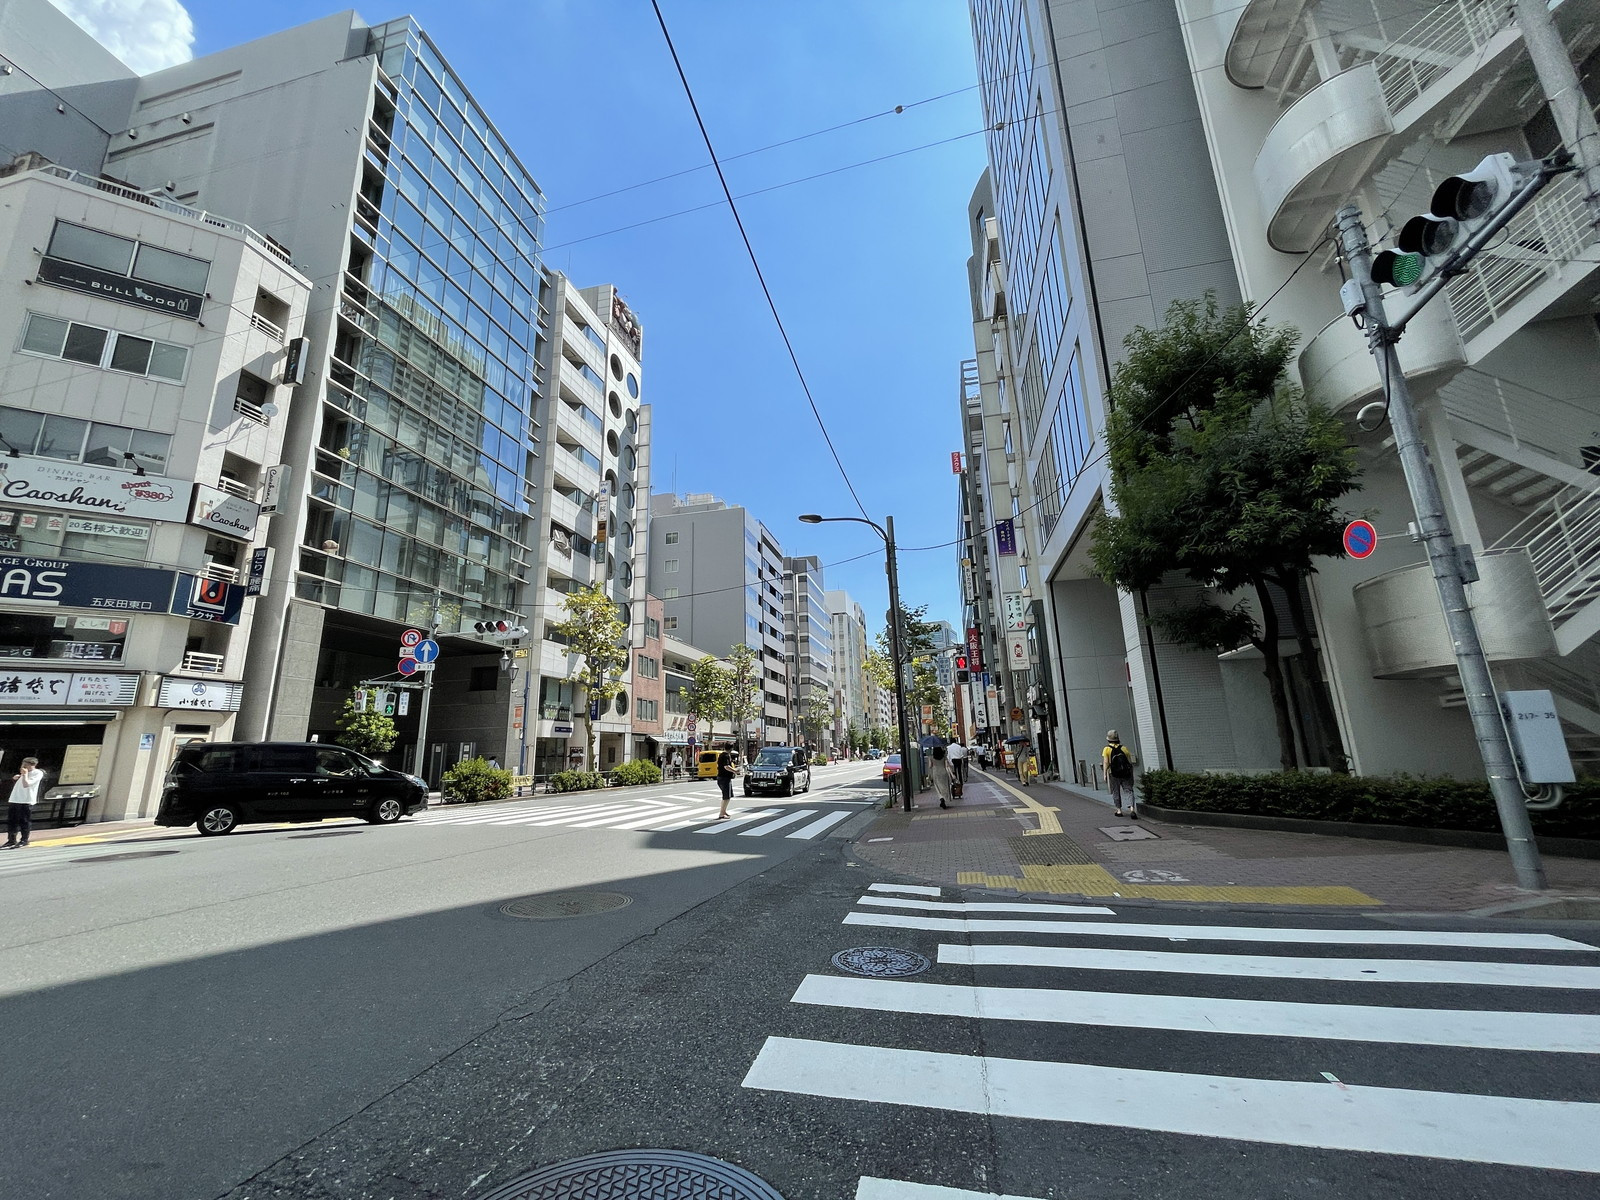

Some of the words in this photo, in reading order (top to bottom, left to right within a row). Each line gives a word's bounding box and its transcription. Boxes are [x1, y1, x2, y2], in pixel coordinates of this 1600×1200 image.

[91, 281, 132, 297] BULL
[144, 292, 176, 307] DOG
[37, 466, 83, 478] DINING
[89, 472, 111, 482] BAR
[121, 481, 152, 489] about
[210, 512, 250, 532] Caoshan
[24, 557, 69, 570] GROUP
[0, 568, 67, 597] AS
[90, 597, 152, 610] 五反田東口
[1005, 595, 1016, 629] ラーメン
[969, 634, 980, 666] 大阪王将
